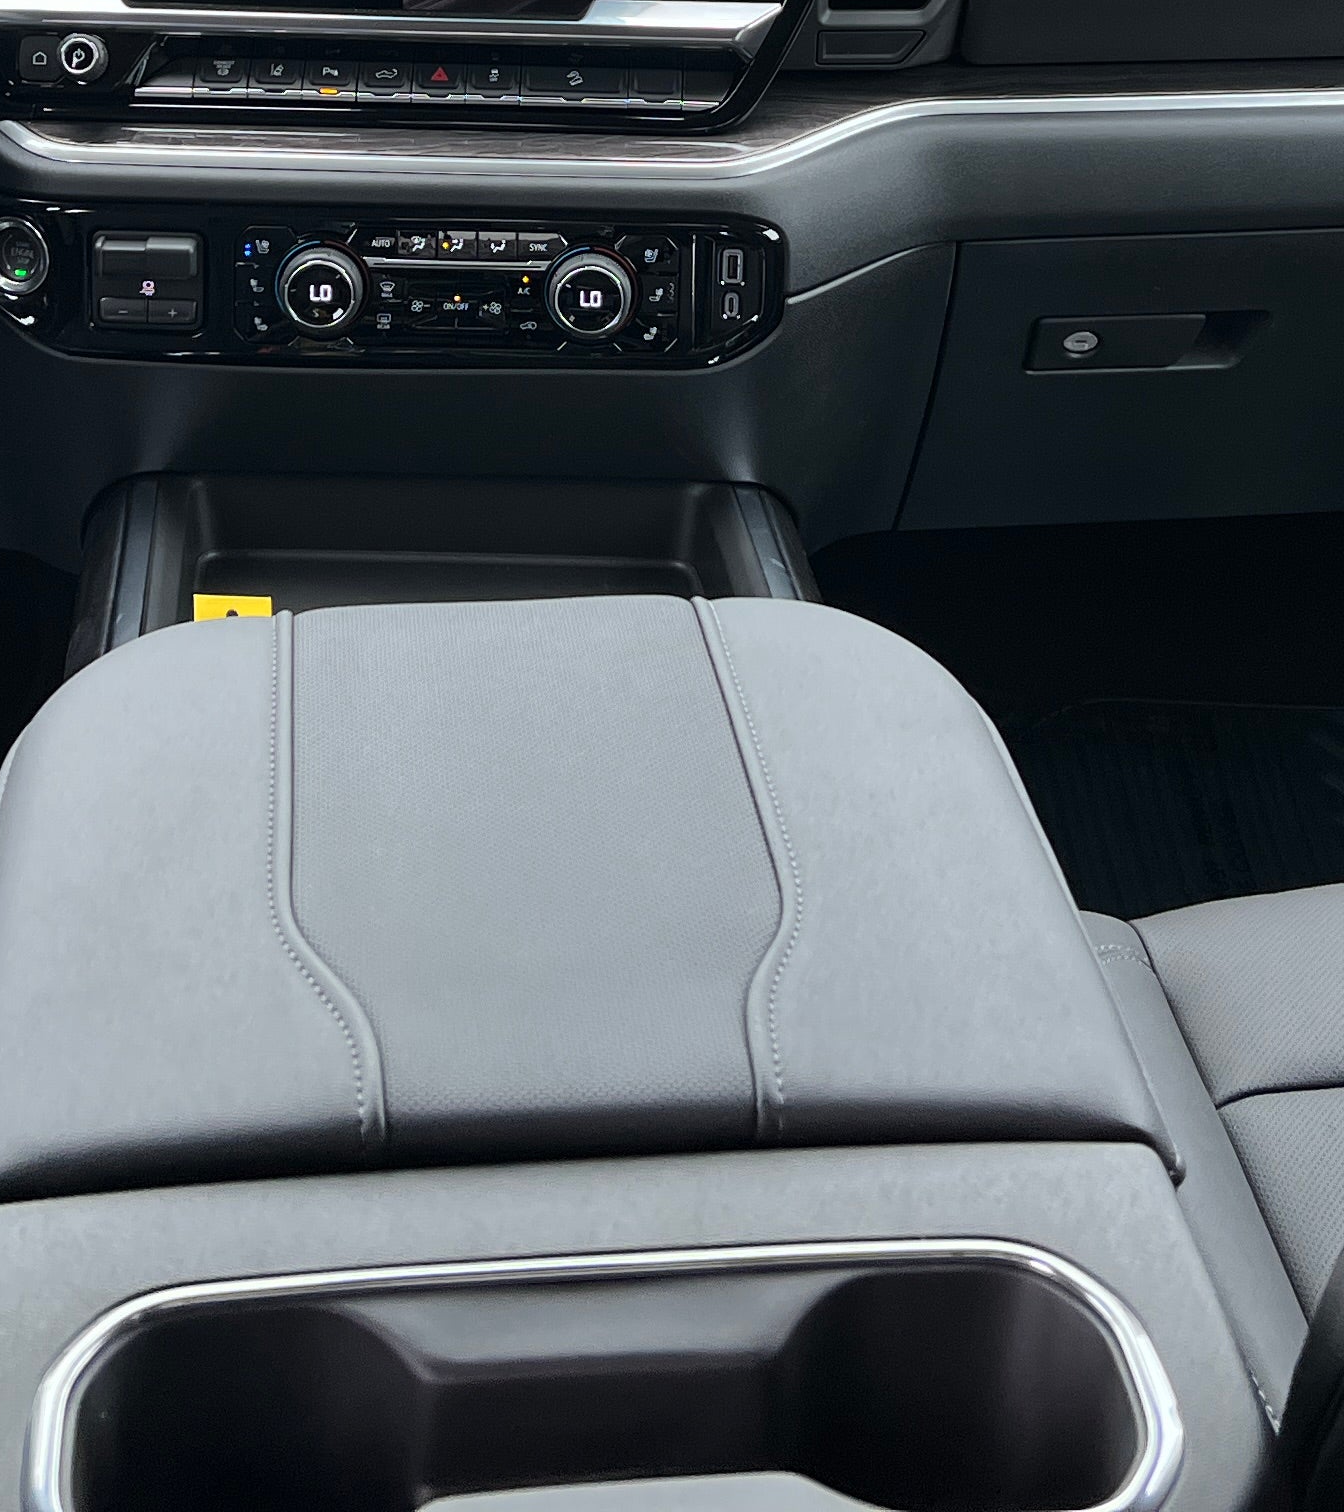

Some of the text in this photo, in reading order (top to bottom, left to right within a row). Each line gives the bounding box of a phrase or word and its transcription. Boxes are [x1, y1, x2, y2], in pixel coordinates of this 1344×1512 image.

[371, 239, 391, 248] AUTO
[529, 244, 547, 253] SYNC
[309, 284, 332, 303] LO
[517, 287, 530, 295] A/C
[579, 290, 601, 308] LO
[443, 303, 468, 311] ON/OFF
